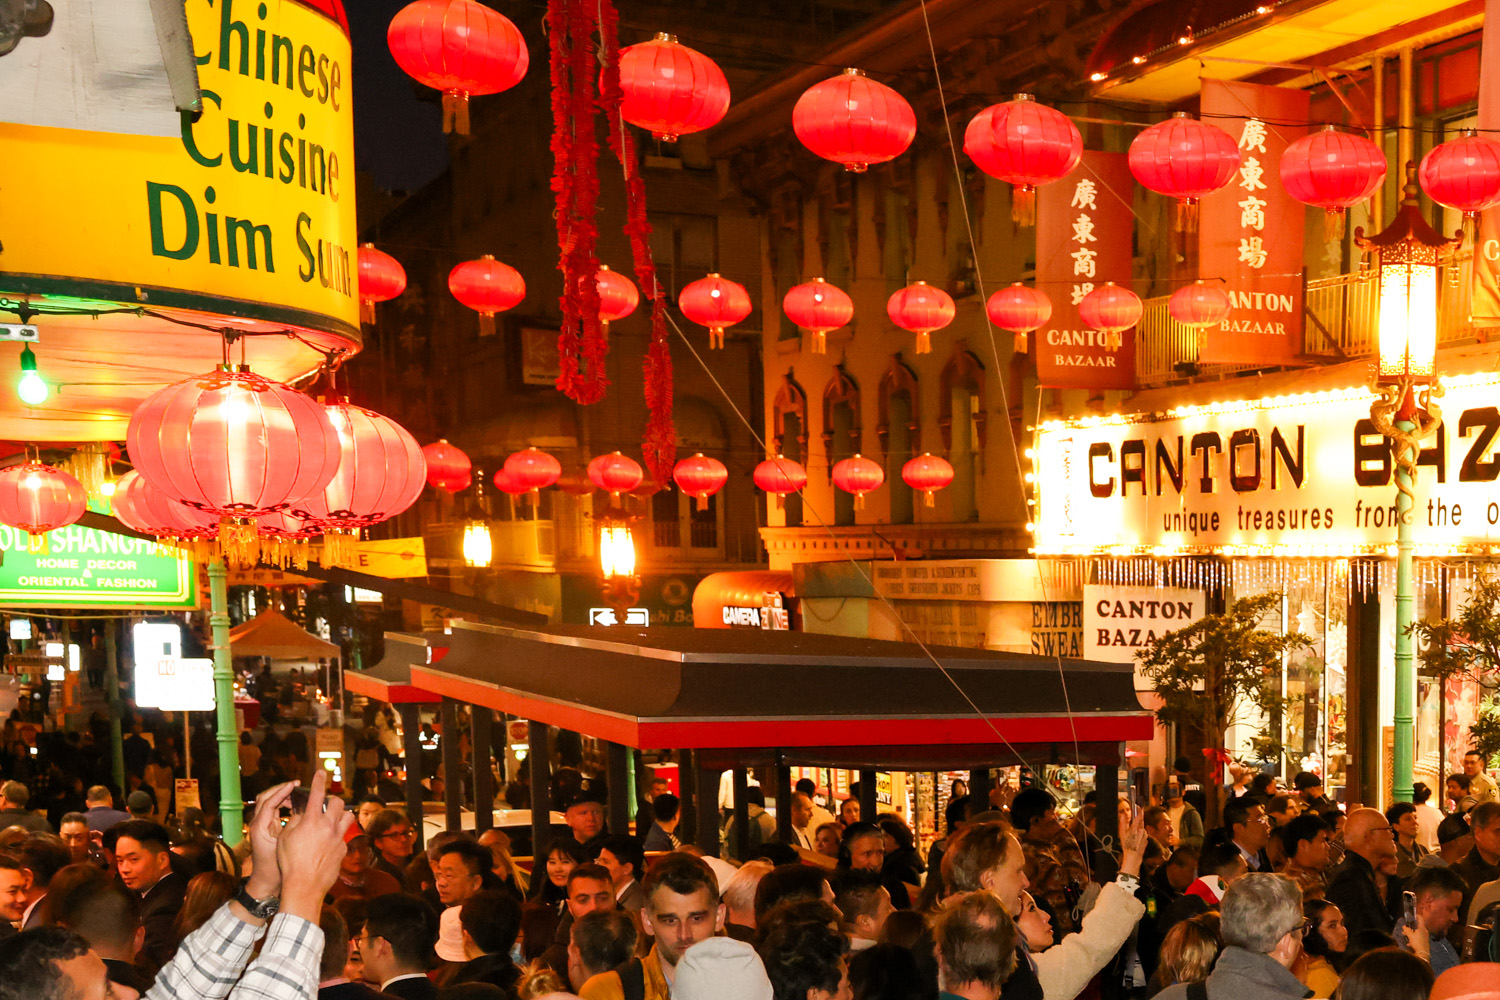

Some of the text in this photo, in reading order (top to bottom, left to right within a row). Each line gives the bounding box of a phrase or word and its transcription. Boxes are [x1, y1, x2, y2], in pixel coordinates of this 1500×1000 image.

[180, 89, 340, 203] Cuisine
[1238, 117, 1268, 269] 廣東商場
[146, 180, 352, 298] Dim Sum
[1228, 290, 1294, 313] ANTON
[1220, 319, 1286, 336] BAZAAR
[1055, 354, 1117, 368] BAZAAR
[1088, 424, 1306, 498] CANTON
[1163, 507, 1220, 537] unique
[1237, 504, 1334, 531] treasures
[1427, 496, 1462, 527] the
[36, 558, 137, 570] HOME DECOR
[82, 568, 93, 579] &
[18, 576, 157, 589] ORIENTAL FASHION
[723, 606, 760, 627] CAMERA
[1096, 599, 1193, 620] CANTON
